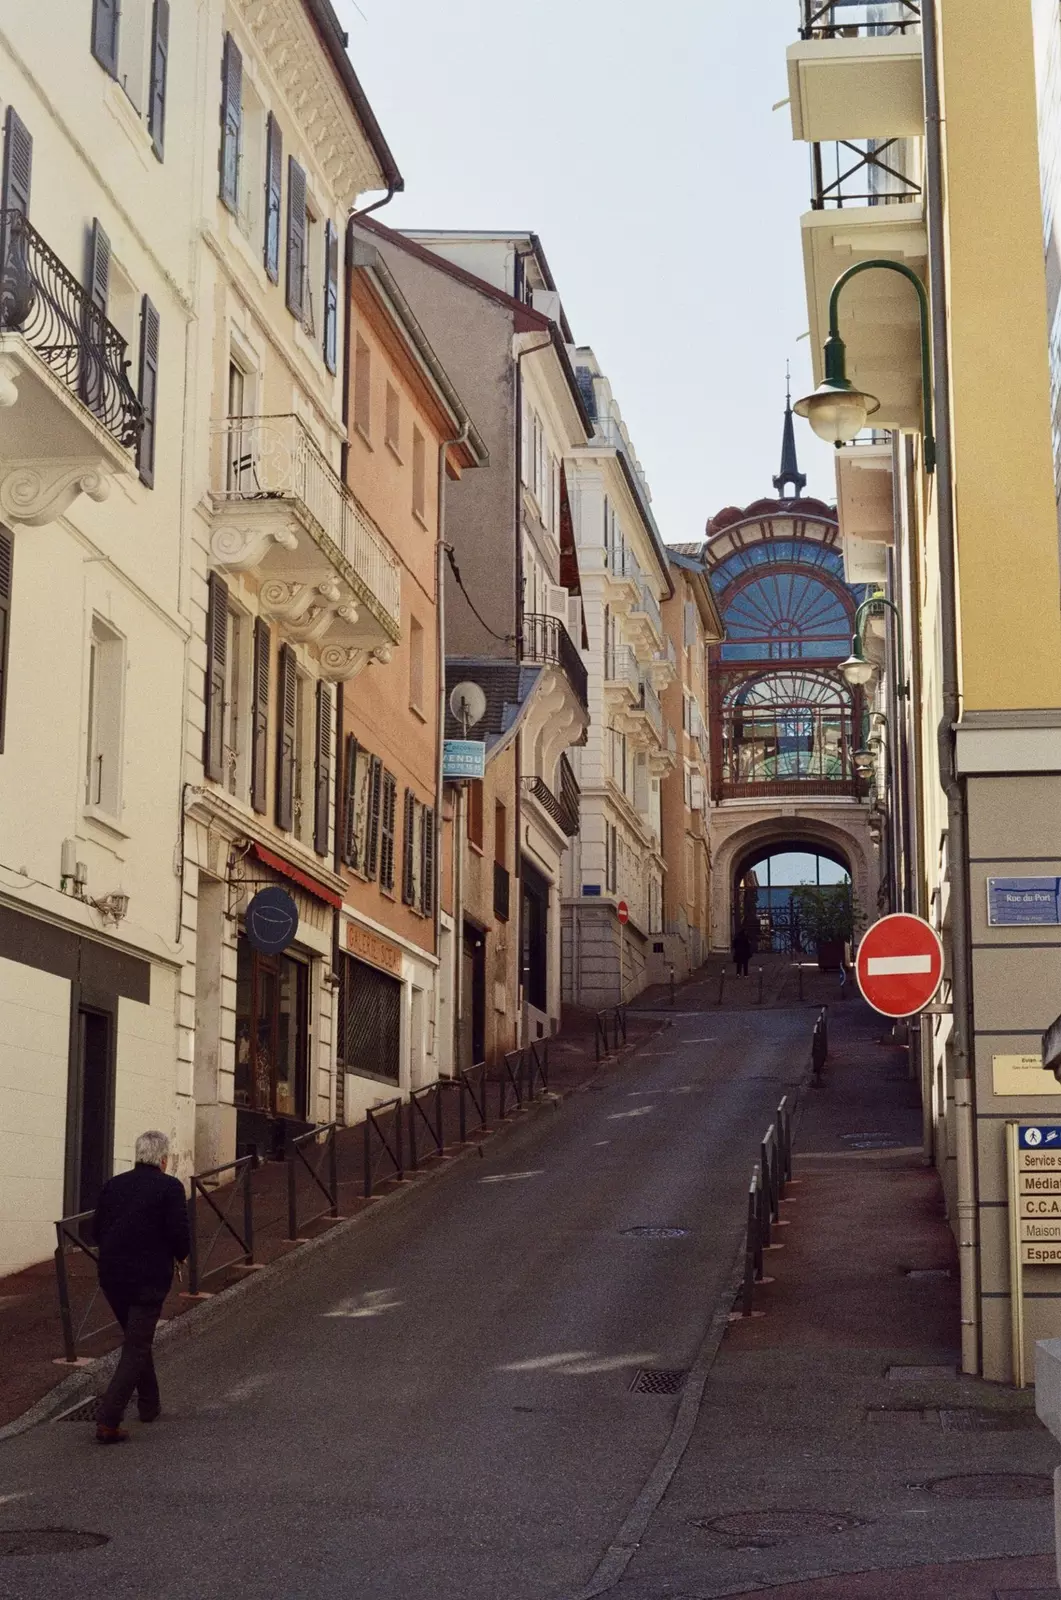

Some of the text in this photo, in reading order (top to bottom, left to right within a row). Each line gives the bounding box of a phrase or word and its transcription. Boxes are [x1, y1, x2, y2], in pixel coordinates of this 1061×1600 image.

[1006, 893, 1051, 902] Rue du Port
[1024, 1154, 1055, 1166] Service
[1026, 1224, 1060, 1236] Maison
